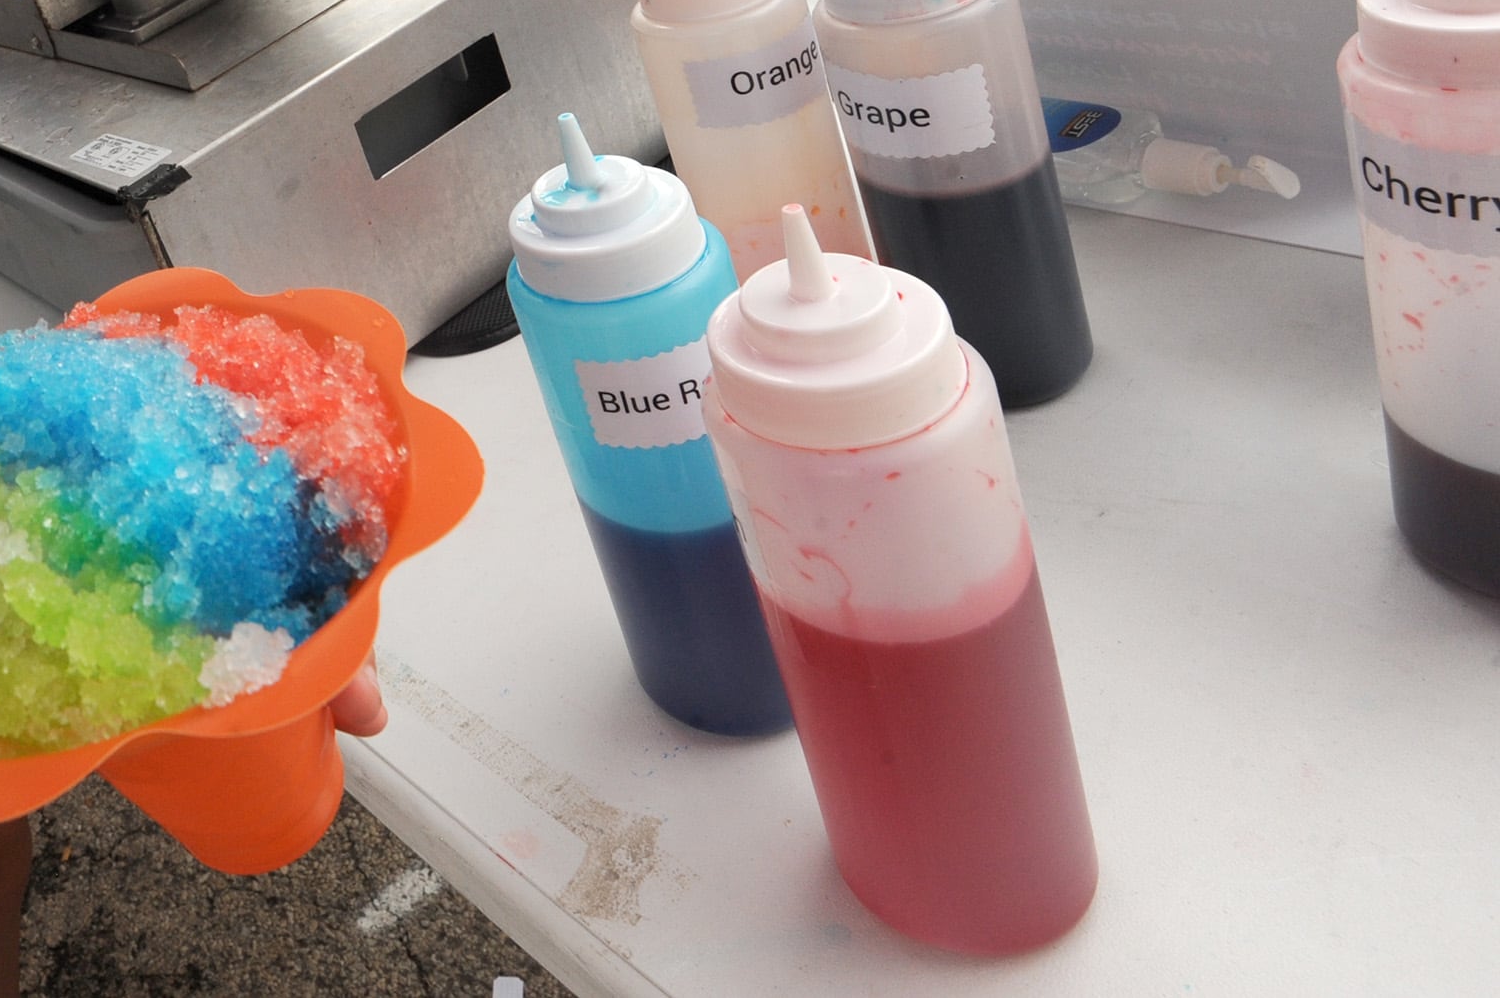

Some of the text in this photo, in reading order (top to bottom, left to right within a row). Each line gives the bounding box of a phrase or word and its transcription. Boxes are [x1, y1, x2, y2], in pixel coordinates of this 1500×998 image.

[730, 40, 819, 96] Orange
[838, 90, 932, 134] Grape
[598, 378, 705, 415] Blue R
